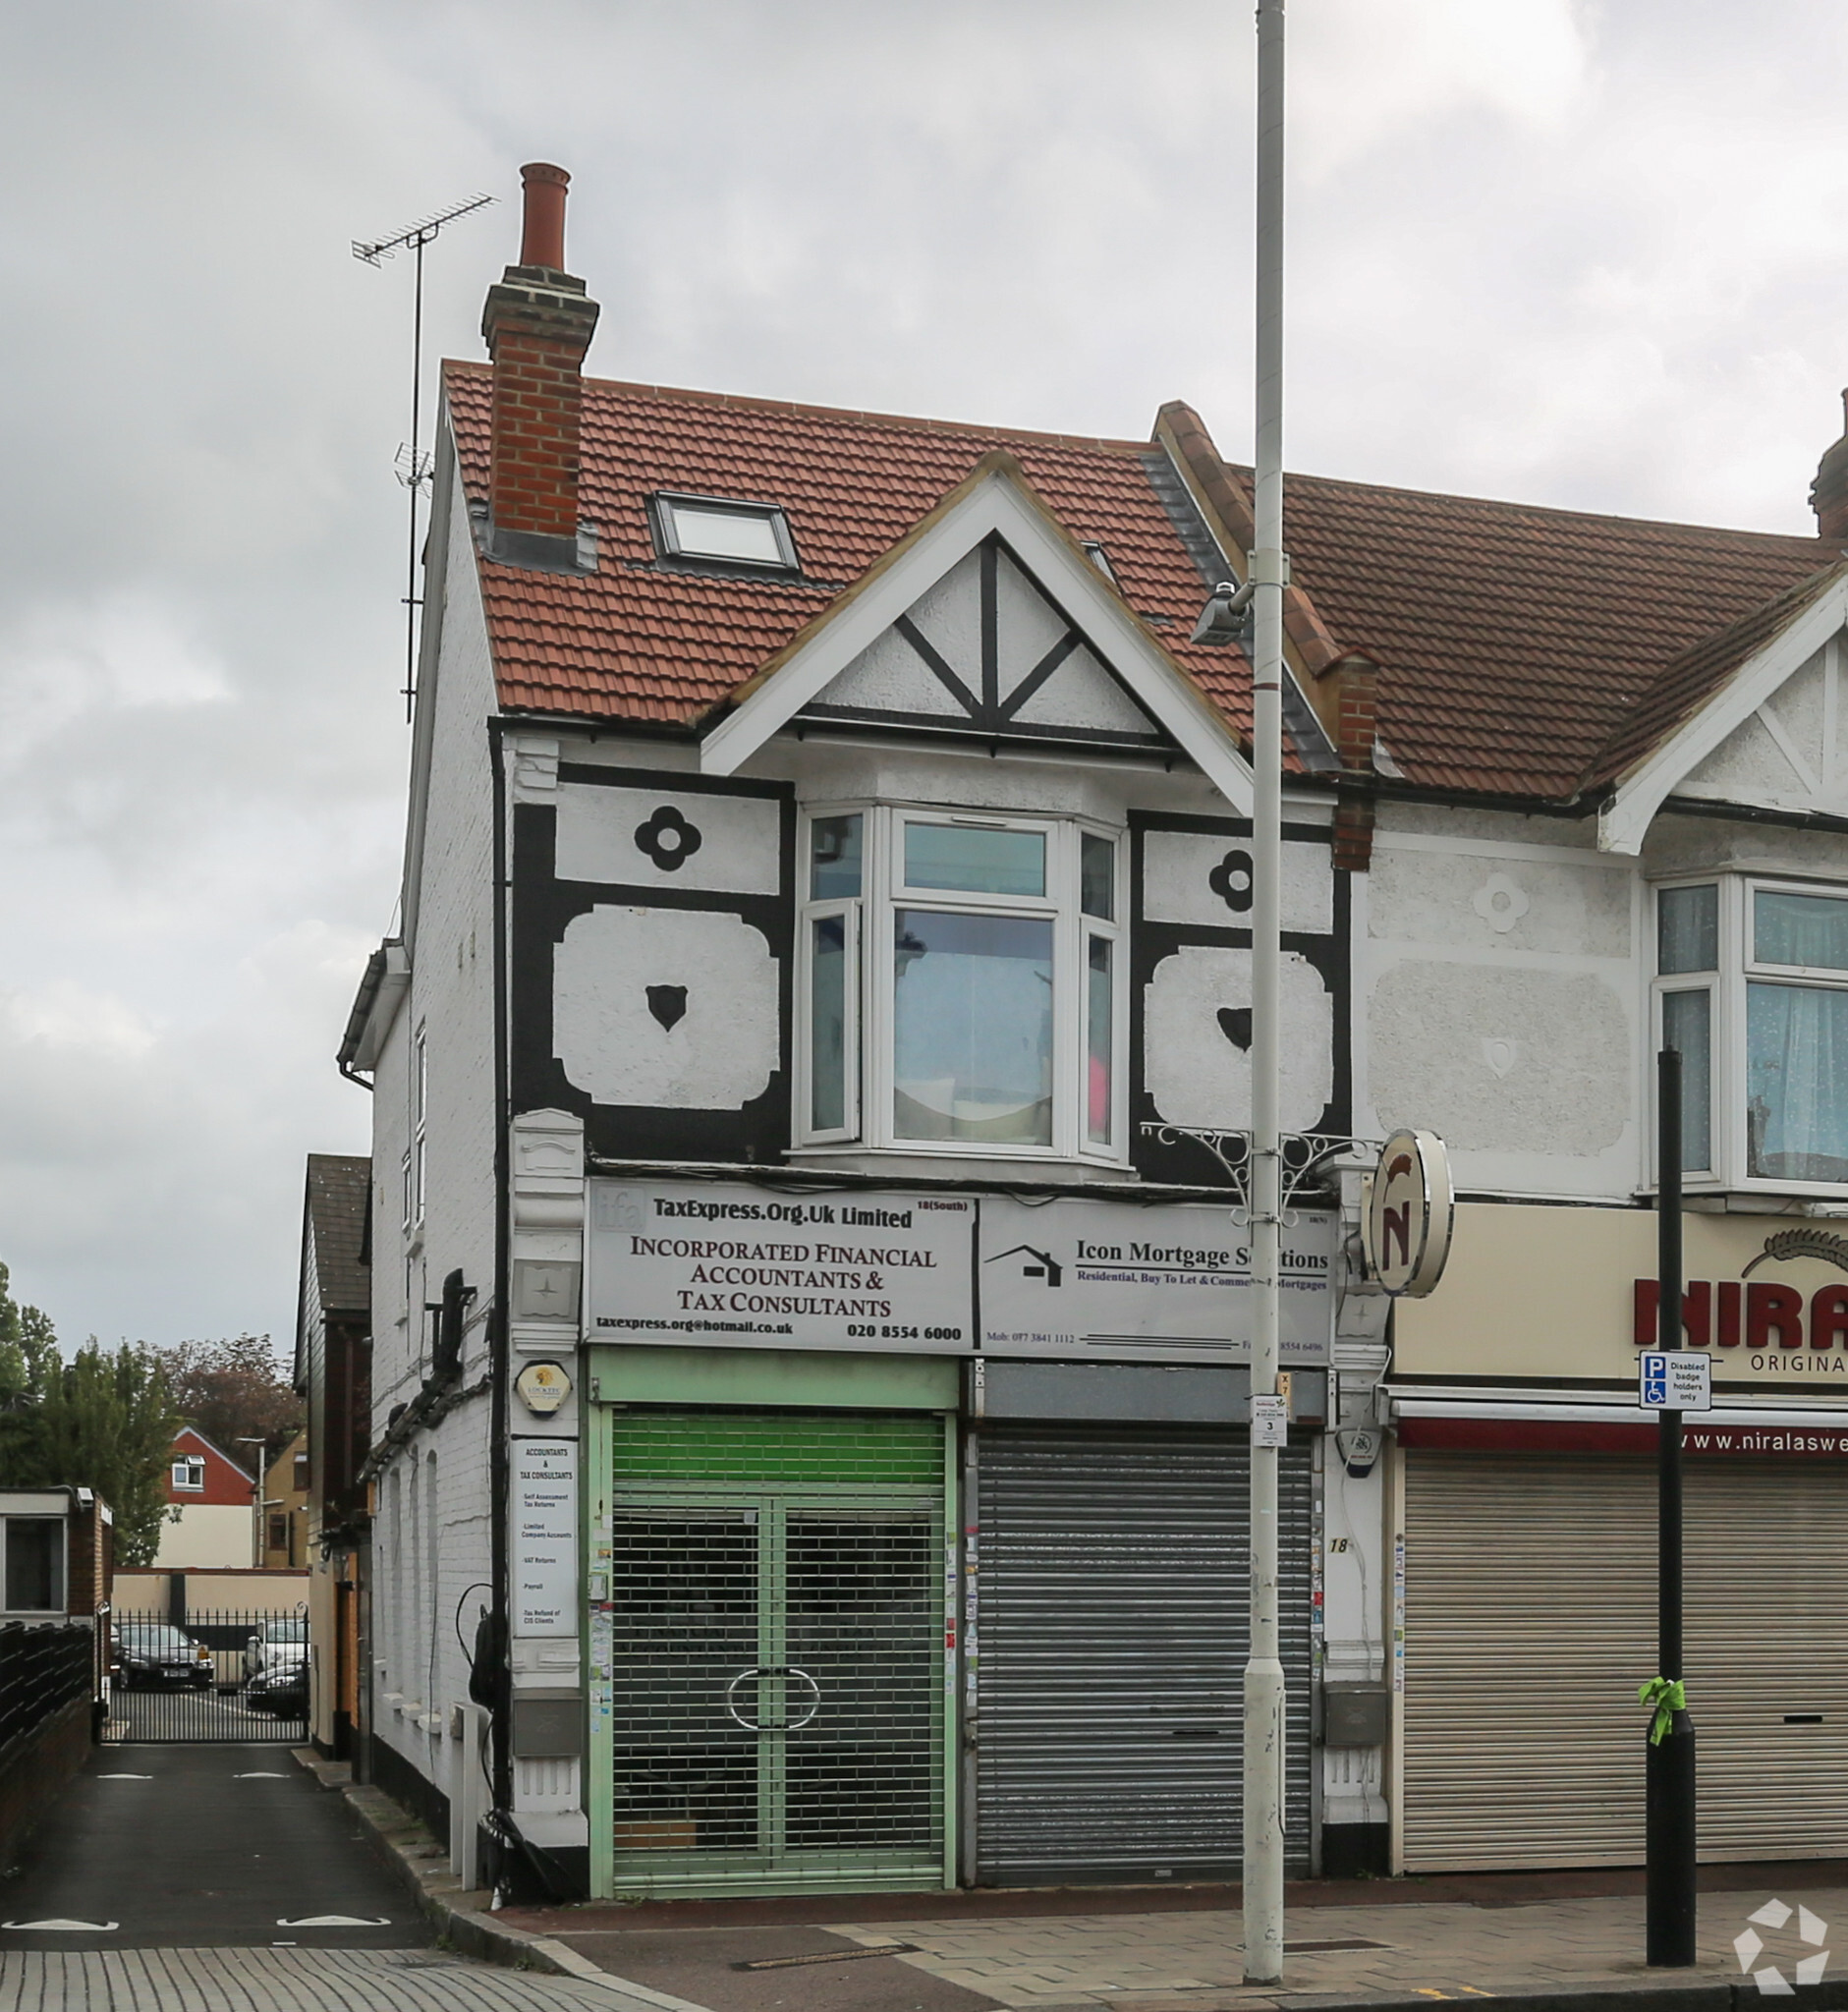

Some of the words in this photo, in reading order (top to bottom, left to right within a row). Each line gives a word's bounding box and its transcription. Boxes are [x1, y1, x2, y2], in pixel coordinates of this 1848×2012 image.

[652, 1199, 835, 1225] TaxExpress.Org.Uk
[842, 1207, 912, 1228] Limited
[917, 1201, 968, 1211] 18(South)
[1382, 1201, 1410, 1271] N
[630, 1236, 810, 1261] INCORPORATED
[814, 1244, 937, 1268] FINANCIAL
[1077, 1240, 1122, 1259] Icon
[1129, 1243, 1229, 1268] Mortgage
[1235, 1247, 1328, 1269] Stions
[690, 1263, 861, 1289] ACCOUNTANTS
[866, 1270, 884, 1290] &
[1077, 1270, 1138, 1283] Residential,
[1141, 1273, 1160, 1285] Buy
[1163, 1273, 1177, 1284] To
[1180, 1274, 1197, 1285] Let
[1199, 1275, 1208, 1285] &
[677, 1290, 726, 1312] TAX
[730, 1292, 891, 1317] CONSULTANTS
[596, 1316, 793, 1334] taxexpress.org@hotmail.co.uk
[847, 1324, 876, 1337] 020
[881, 1326, 920, 1339] 8554
[924, 1327, 962, 1340] 6000
[986, 1331, 1010, 1341] Mob:
[1012, 1332, 1029, 1342] 077
[1031, 1333, 1051, 1343] 3841
[1054, 1334, 1075, 1344] 1112
[1280, 1341, 1301, 1351] 8554
[1650, 1359, 1663, 1377] P
[1671, 1362, 1705, 1370] Disabled
[1751, 1355, 1845, 1371] ORIGINA
[1267, 1422, 1273, 1430] 3
[1330, 1538, 1347, 1552] 18
